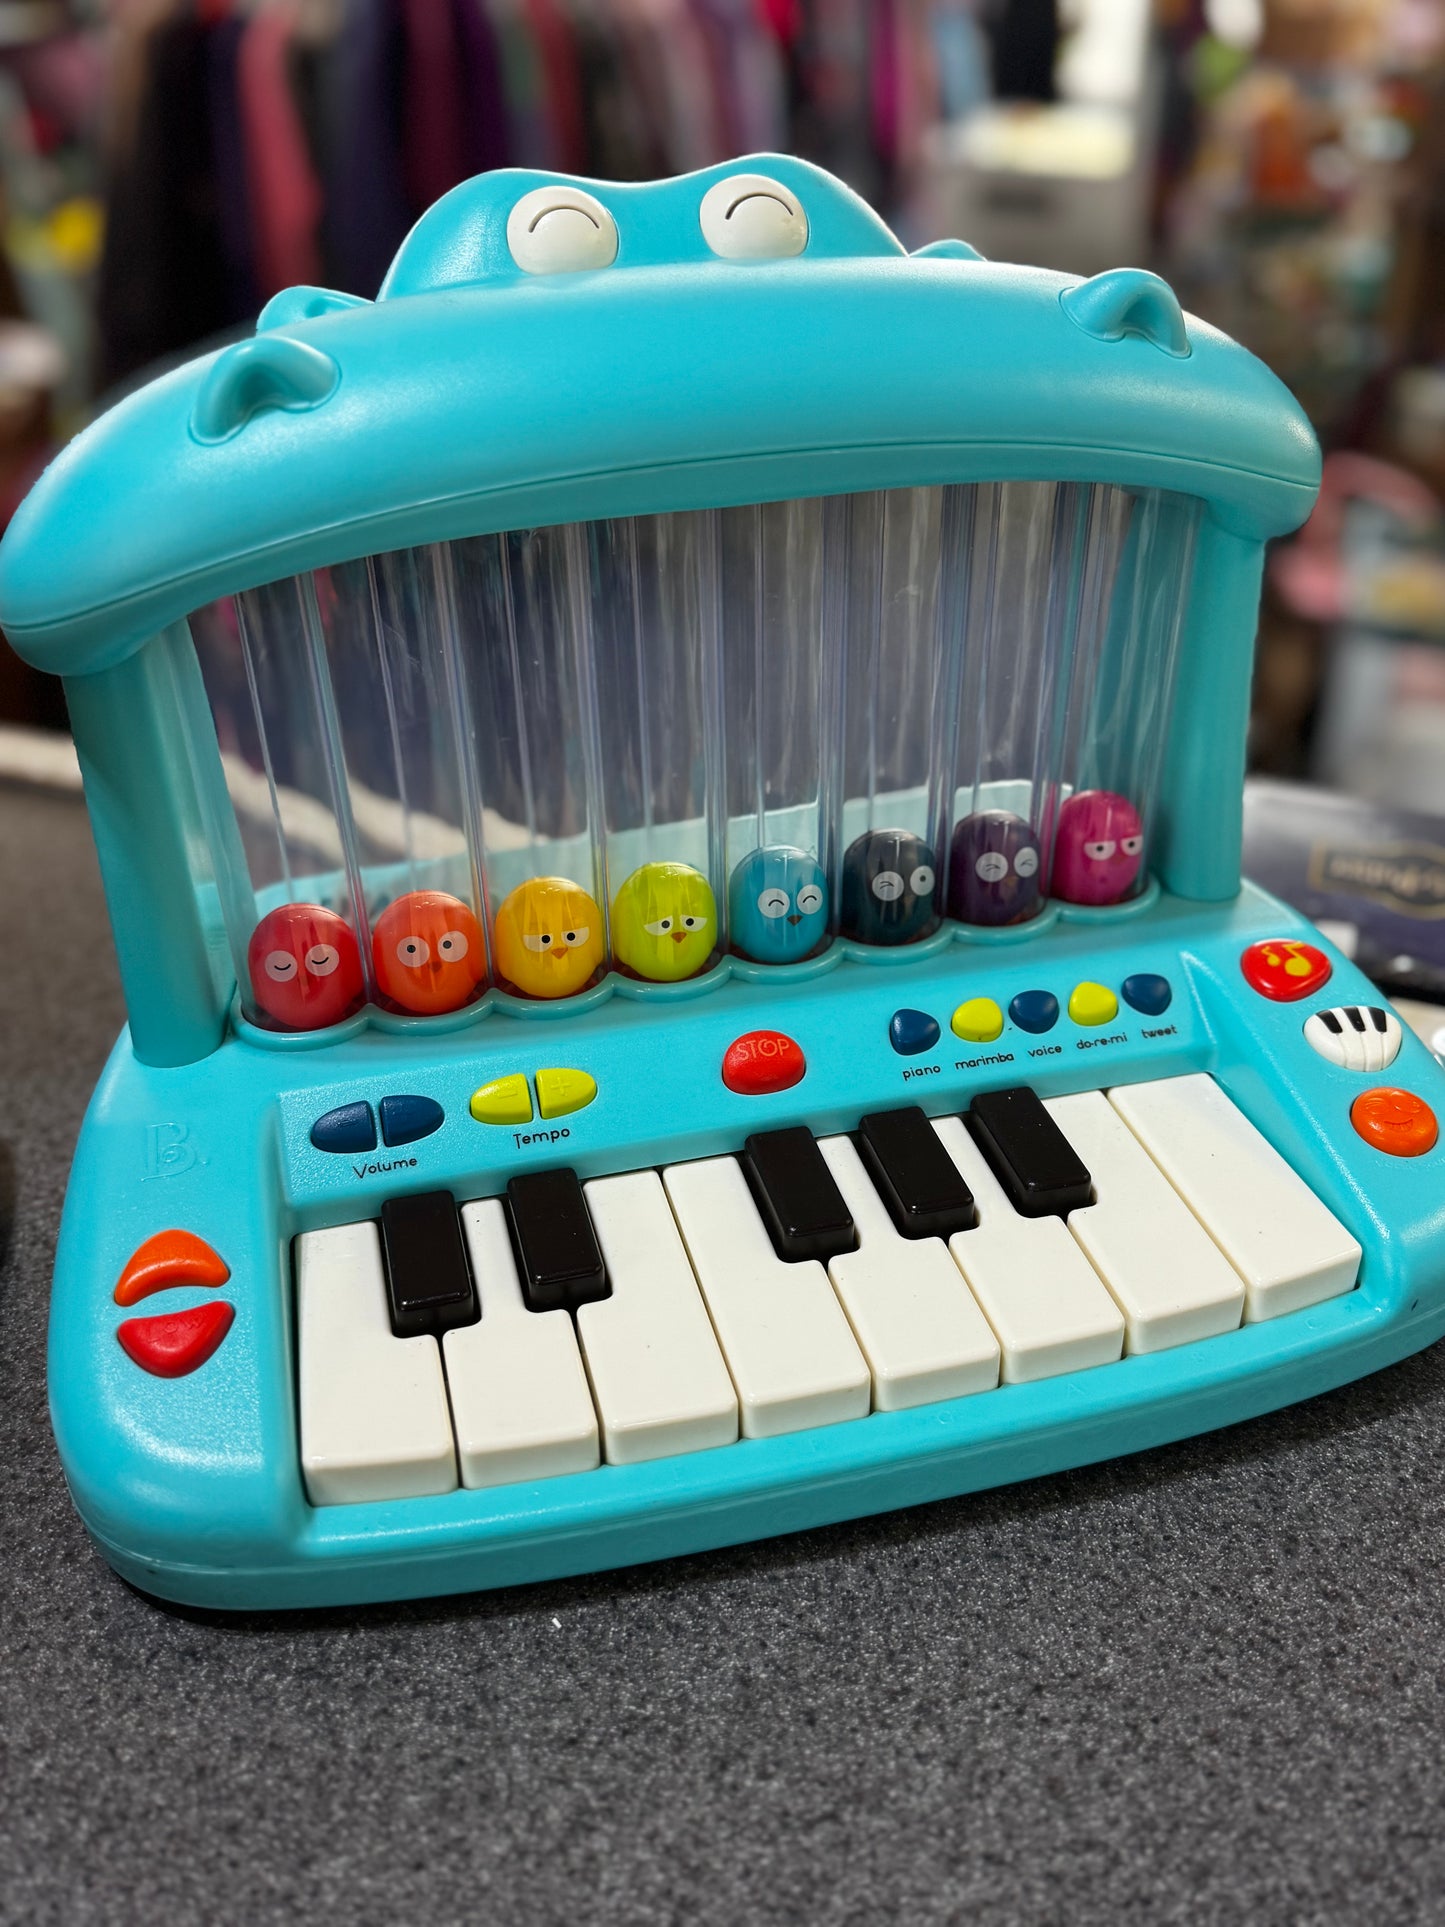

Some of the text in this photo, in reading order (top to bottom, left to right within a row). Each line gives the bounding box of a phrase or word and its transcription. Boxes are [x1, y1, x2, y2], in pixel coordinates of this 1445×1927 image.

[1141, 1024, 1178, 1039] tweet
[735, 1038, 791, 1061] STOP
[1027, 1045, 1063, 1058] voice
[954, 1052, 1015, 1070] marimba
[902, 1065, 941, 1081] piano
[512, 1127, 571, 1149] Tempo
[353, 1156, 418, 1179] Volume
